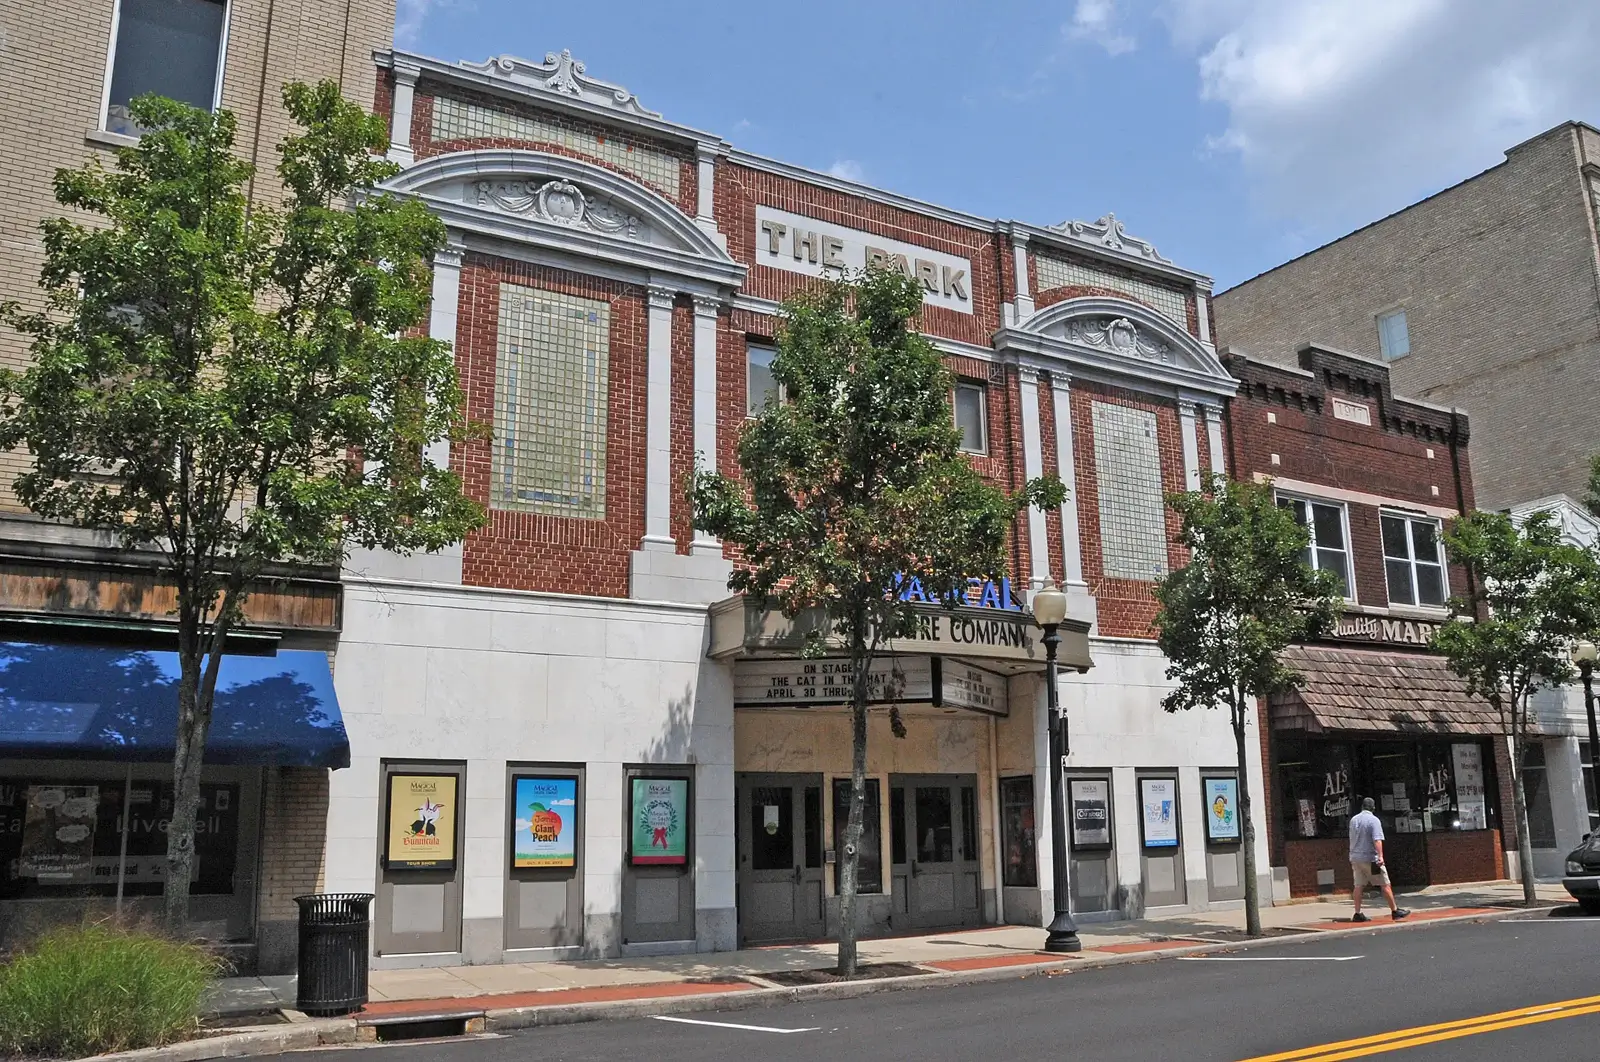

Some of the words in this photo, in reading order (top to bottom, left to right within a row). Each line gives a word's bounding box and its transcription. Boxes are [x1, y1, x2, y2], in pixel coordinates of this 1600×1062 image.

[762, 219, 844, 271] THE
[950, 615, 1028, 648] COMPANY
[1381, 619, 1443, 645] MAR
[804, 664, 816, 674] ON
[822, 663, 852, 674] STAGE
[771, 677, 789, 686] THE
[796, 676, 817, 686] CAT
[824, 675, 834, 685] IN
[867, 673, 886, 684] HAT
[766, 688, 796, 699] APRIL
[804, 688, 816, 697] 30
[822, 687, 848, 697] THRU
[194, 814, 221, 834] ell
[535, 824, 555, 833] Giant
[403, 837, 440, 846] Bunnicula
[532, 833, 558, 842] Peach
